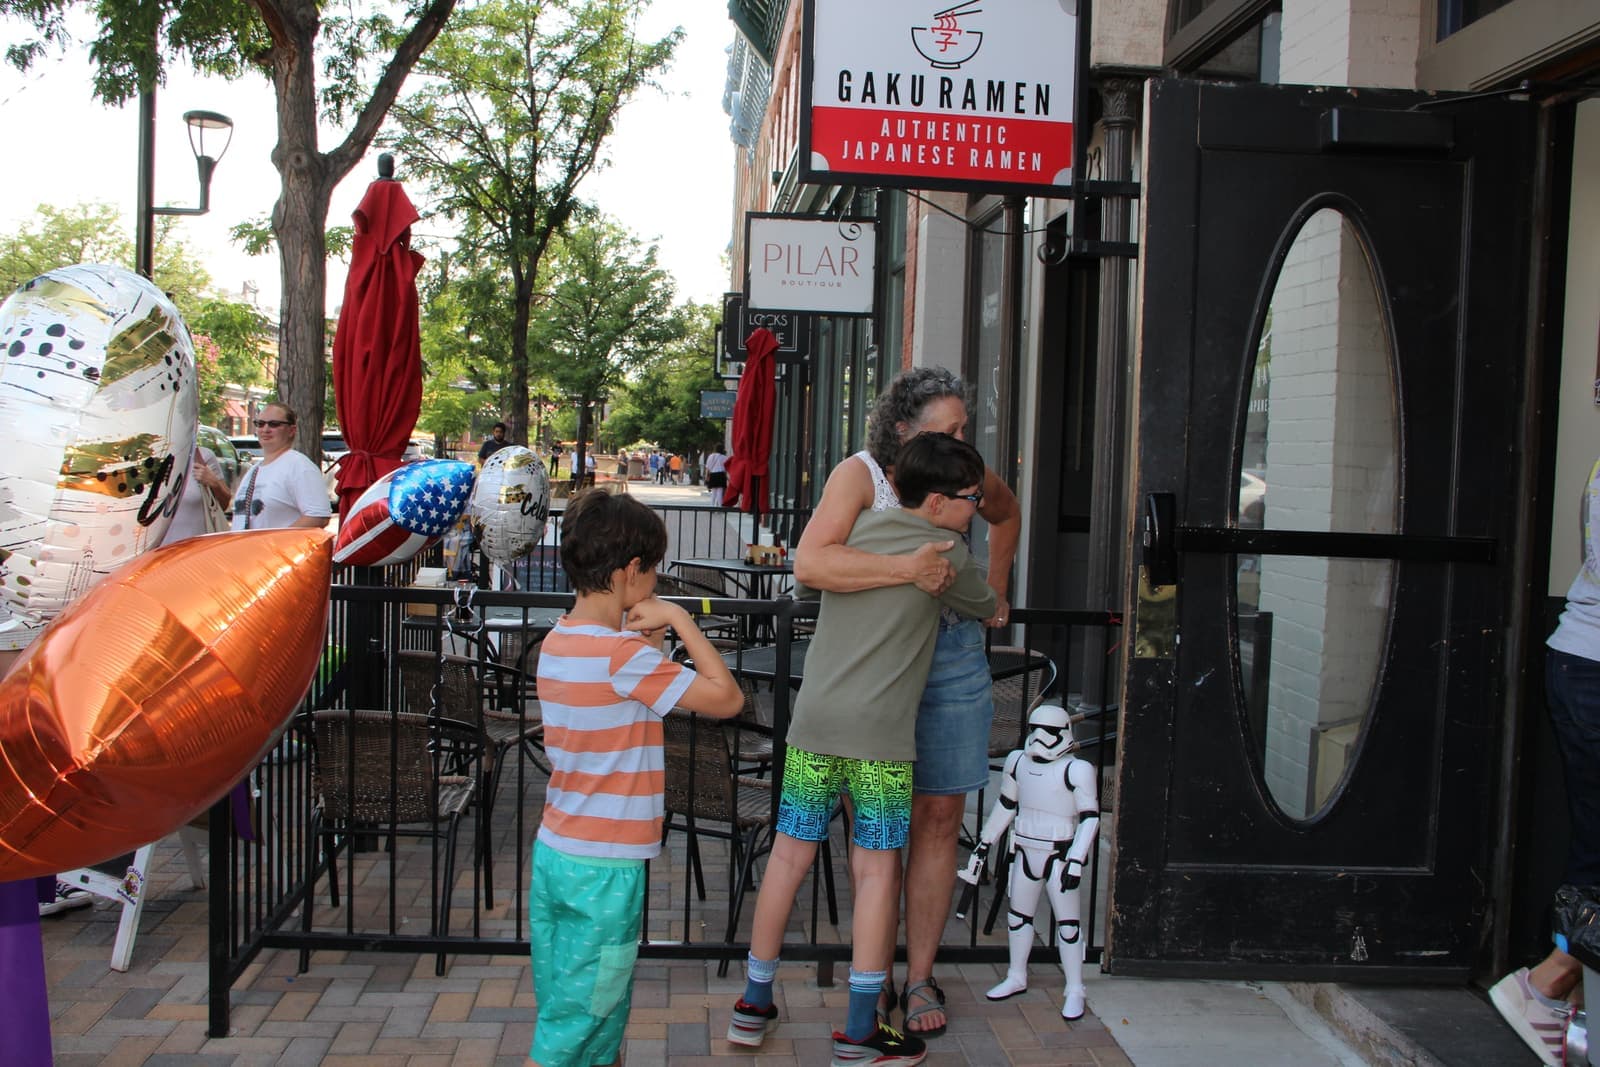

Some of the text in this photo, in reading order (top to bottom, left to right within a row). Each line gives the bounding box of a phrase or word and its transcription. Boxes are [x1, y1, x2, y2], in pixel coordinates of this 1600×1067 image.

[838, 69, 1050, 116] GAKU RAMEN
[881, 118, 1006, 145] AUTHENTIC
[842, 140, 1041, 172] JAPANESE RAMEN
[764, 243, 859, 277] PILAR
[781, 279, 842, 288] BOUTIQUE
